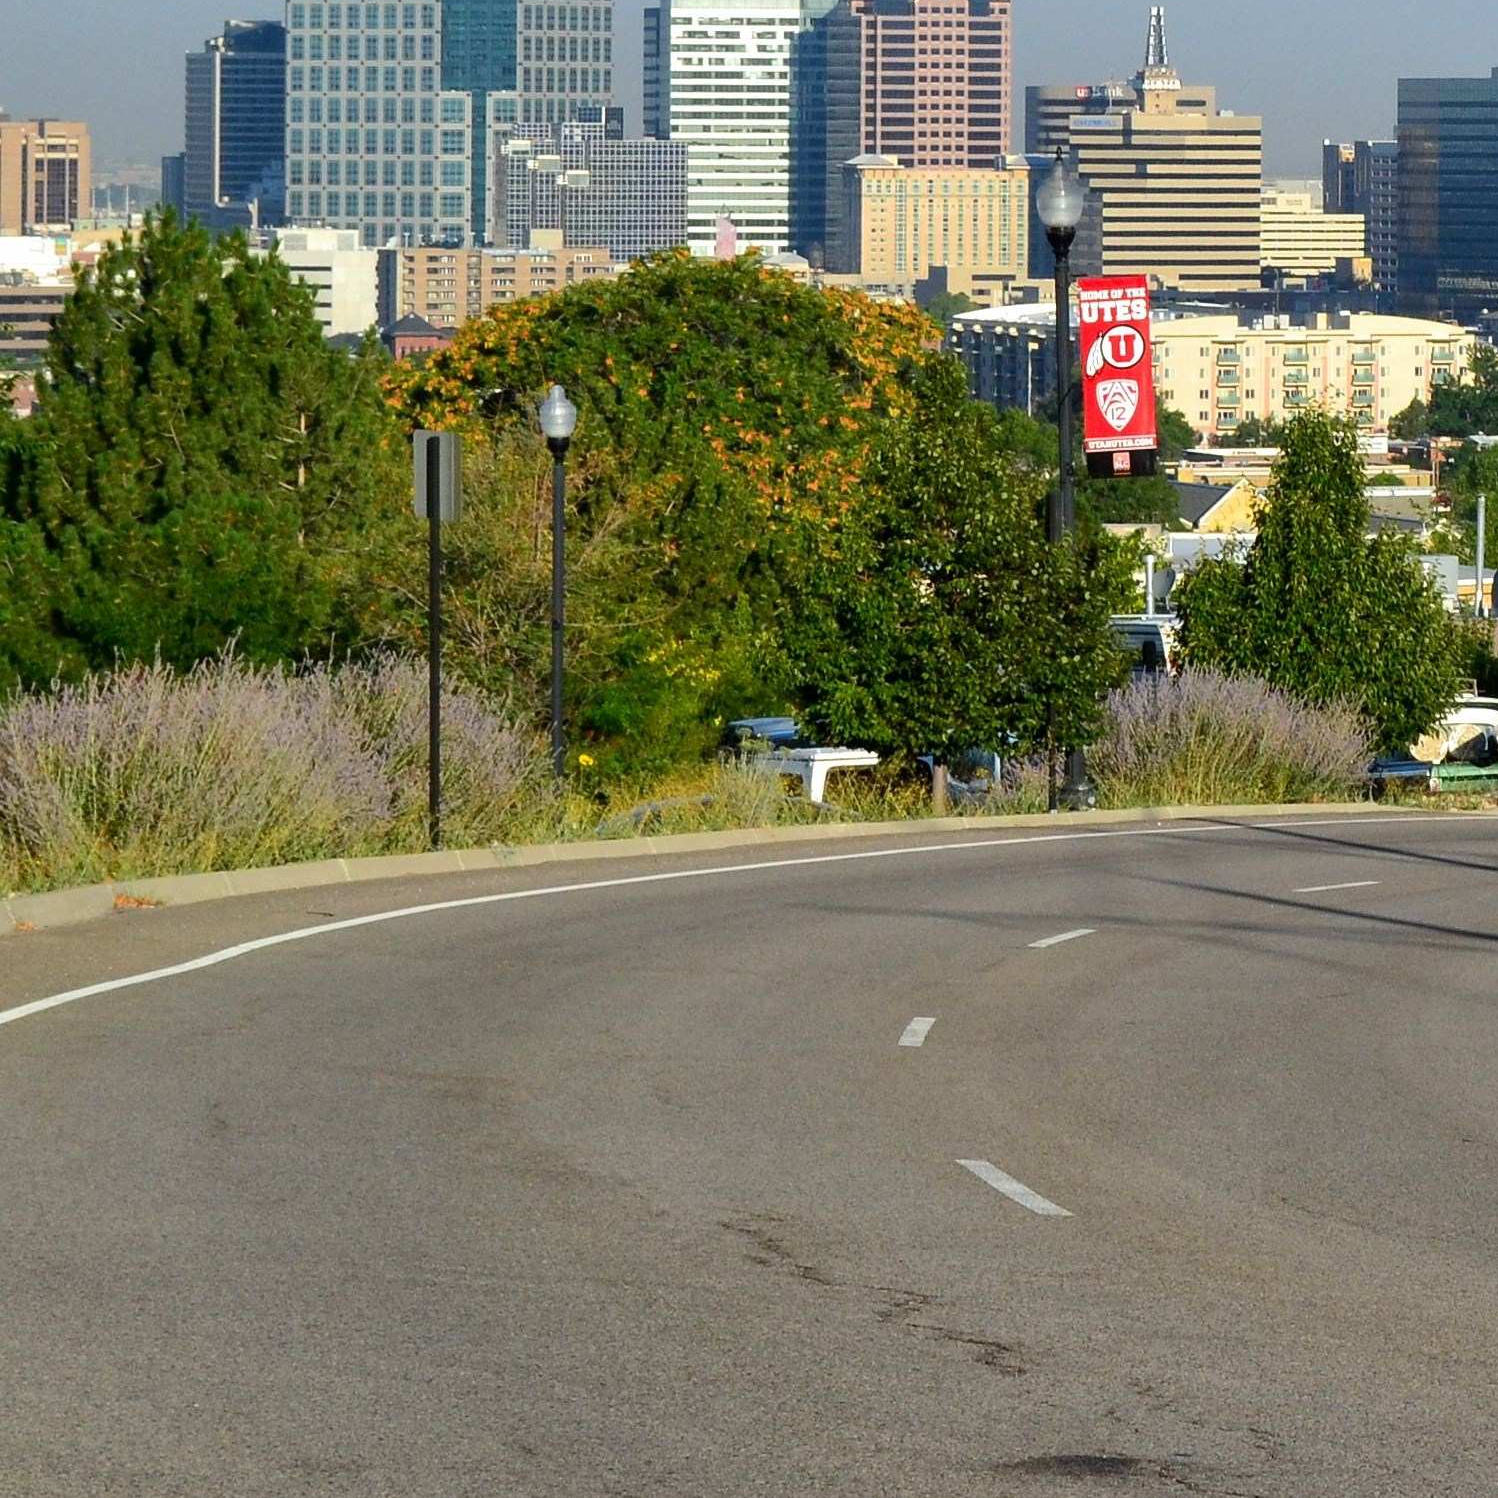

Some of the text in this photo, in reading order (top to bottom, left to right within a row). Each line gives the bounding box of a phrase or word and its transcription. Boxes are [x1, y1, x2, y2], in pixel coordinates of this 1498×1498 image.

[1080, 287, 1146, 301] HOME OF THE
[1081, 299, 1147, 323] UTES
[1108, 334, 1136, 363] U
[1111, 406, 1127, 420] 12
